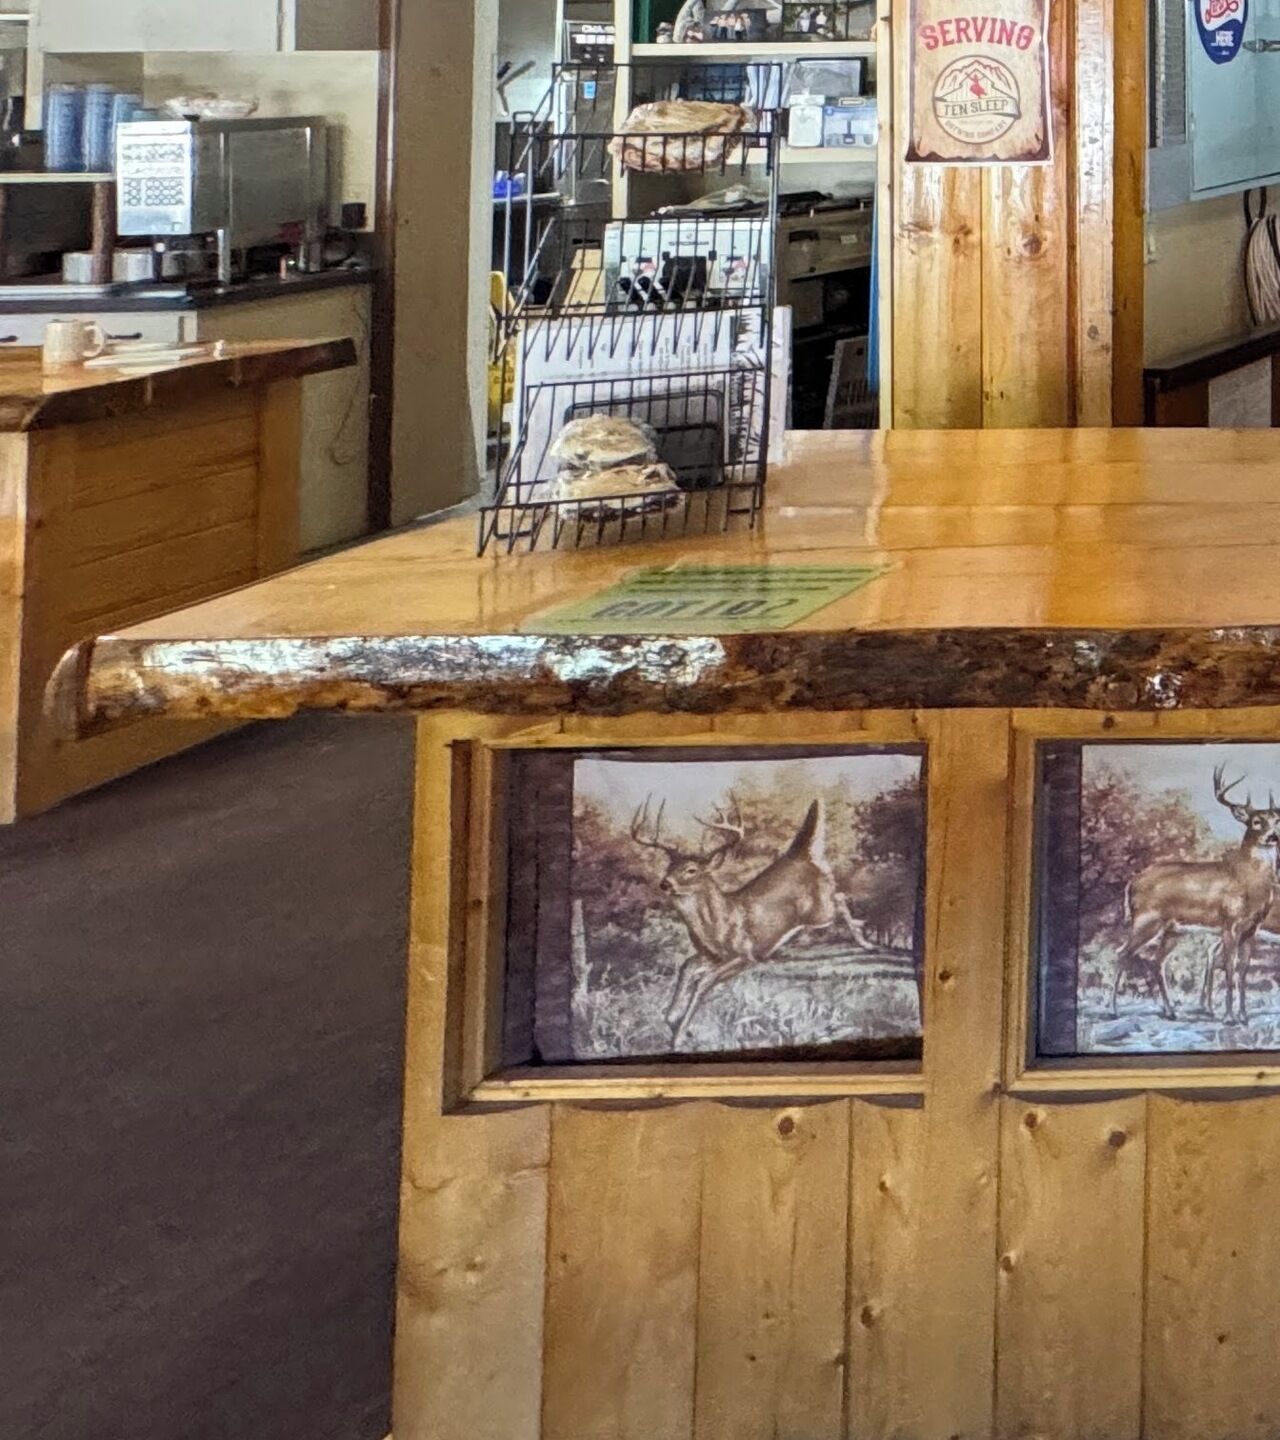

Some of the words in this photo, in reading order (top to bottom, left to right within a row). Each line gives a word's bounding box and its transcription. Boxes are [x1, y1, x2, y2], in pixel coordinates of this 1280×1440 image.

[919, 16, 1036, 51] SERVING
[944, 104, 968, 116] TEN
[970, 100, 1009, 114] SLEEP
